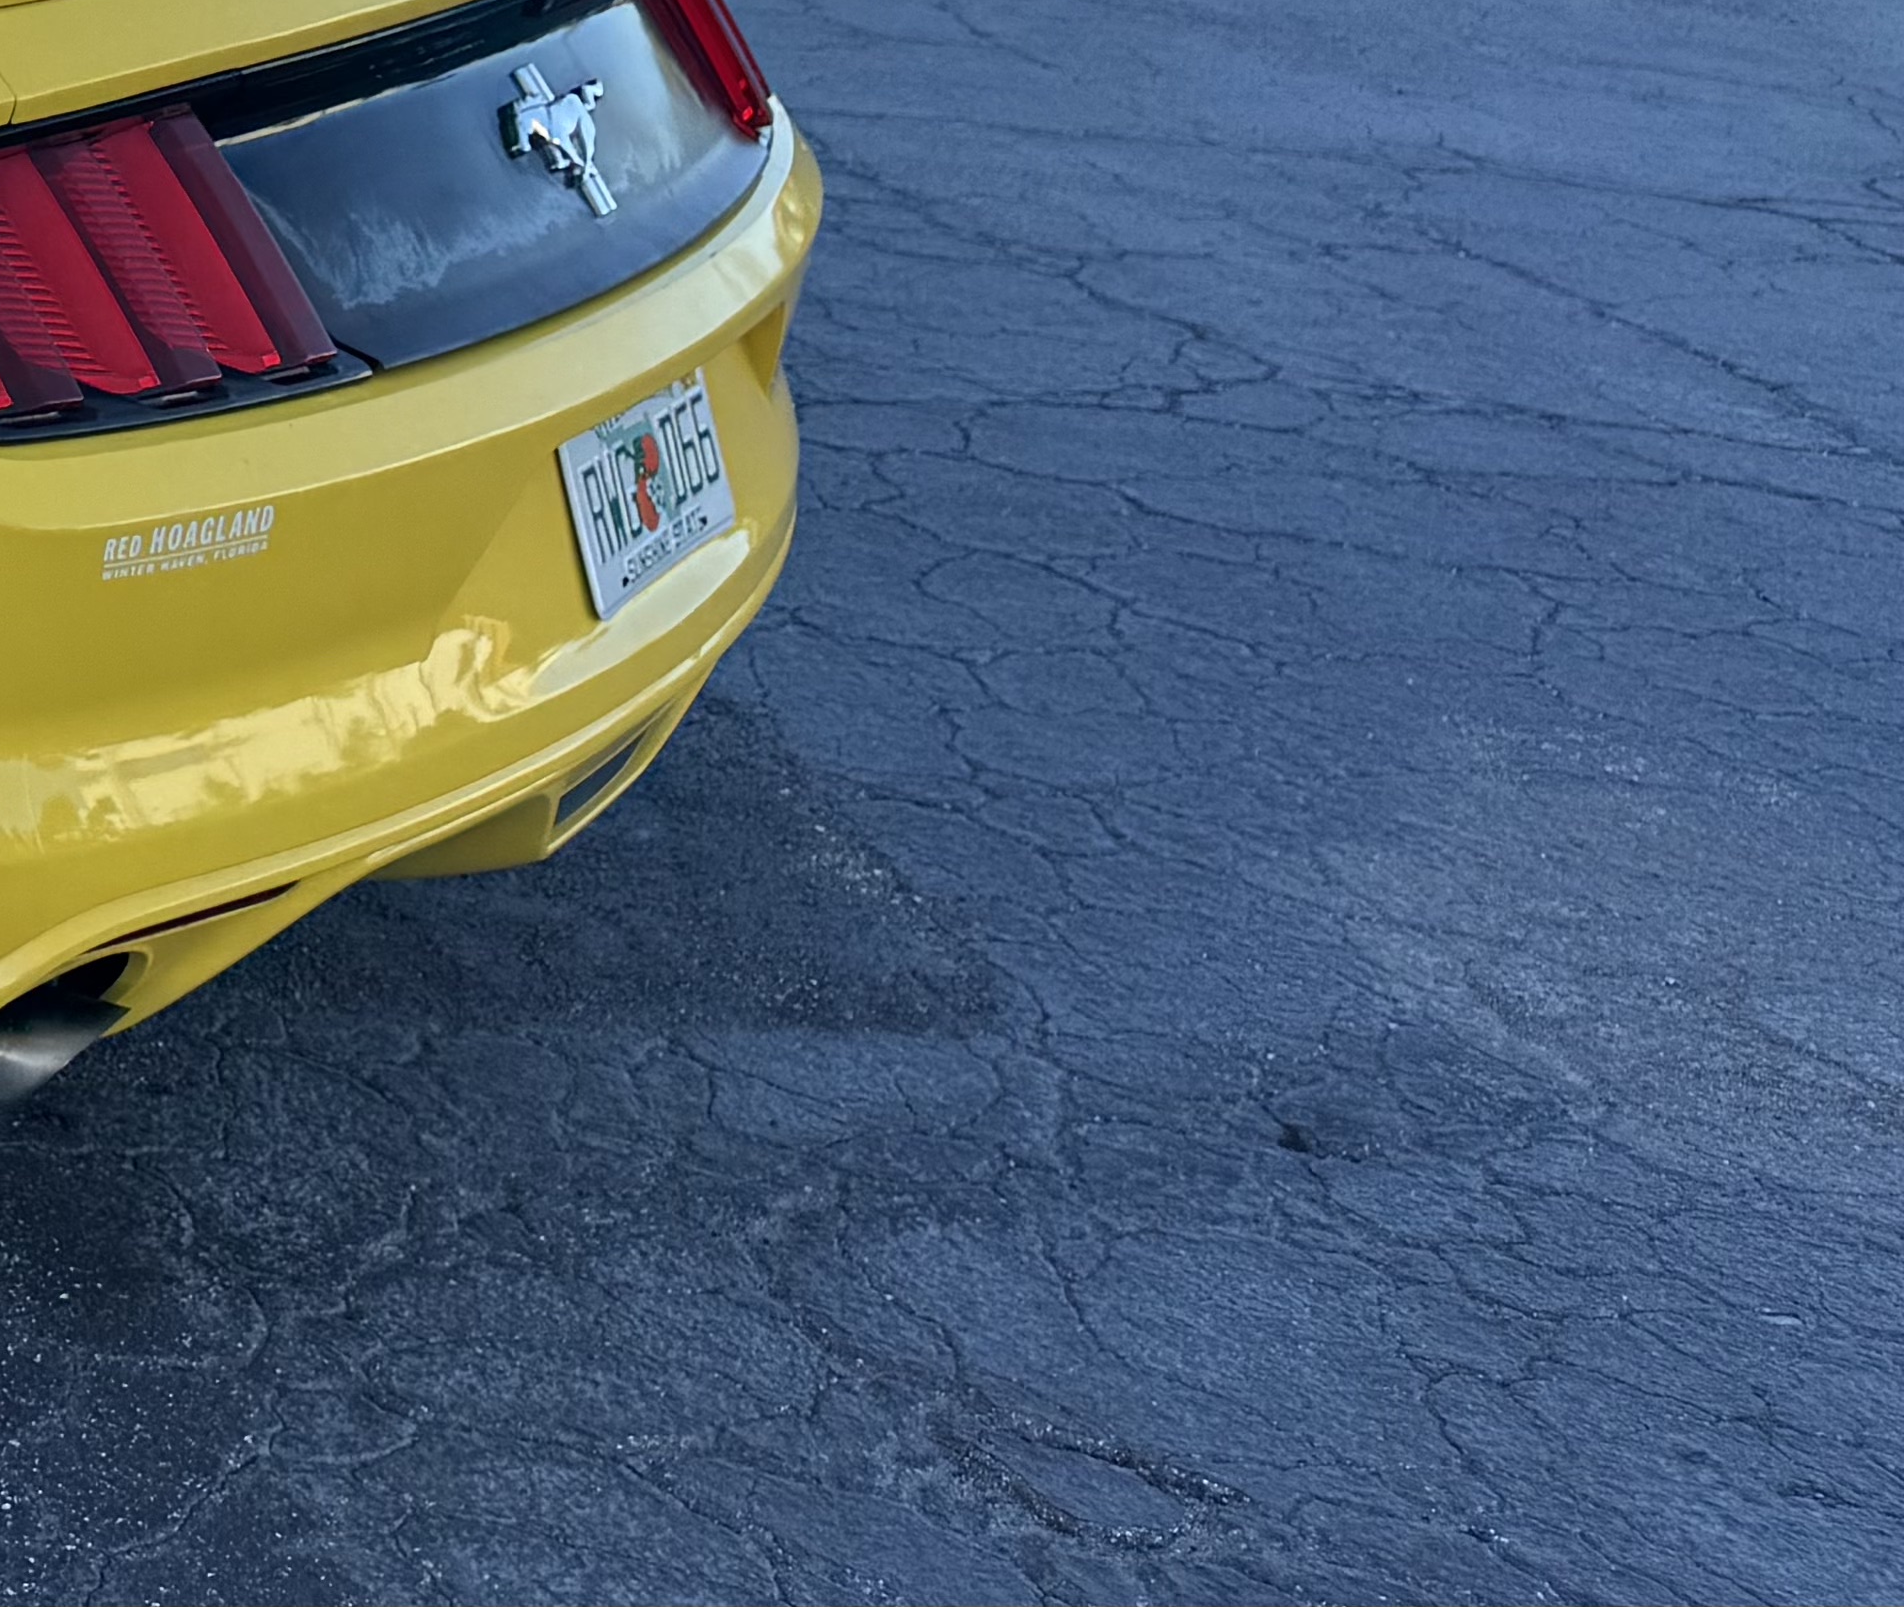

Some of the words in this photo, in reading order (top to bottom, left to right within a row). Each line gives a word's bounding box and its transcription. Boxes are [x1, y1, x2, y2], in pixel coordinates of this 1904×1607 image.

[657, 393, 720, 506] D66
[102, 563, 155, 581] WINTER
[214, 541, 268, 560] FLORIDA
[103, 535, 142, 562] RED
[149, 505, 274, 554] HOAGLAND
